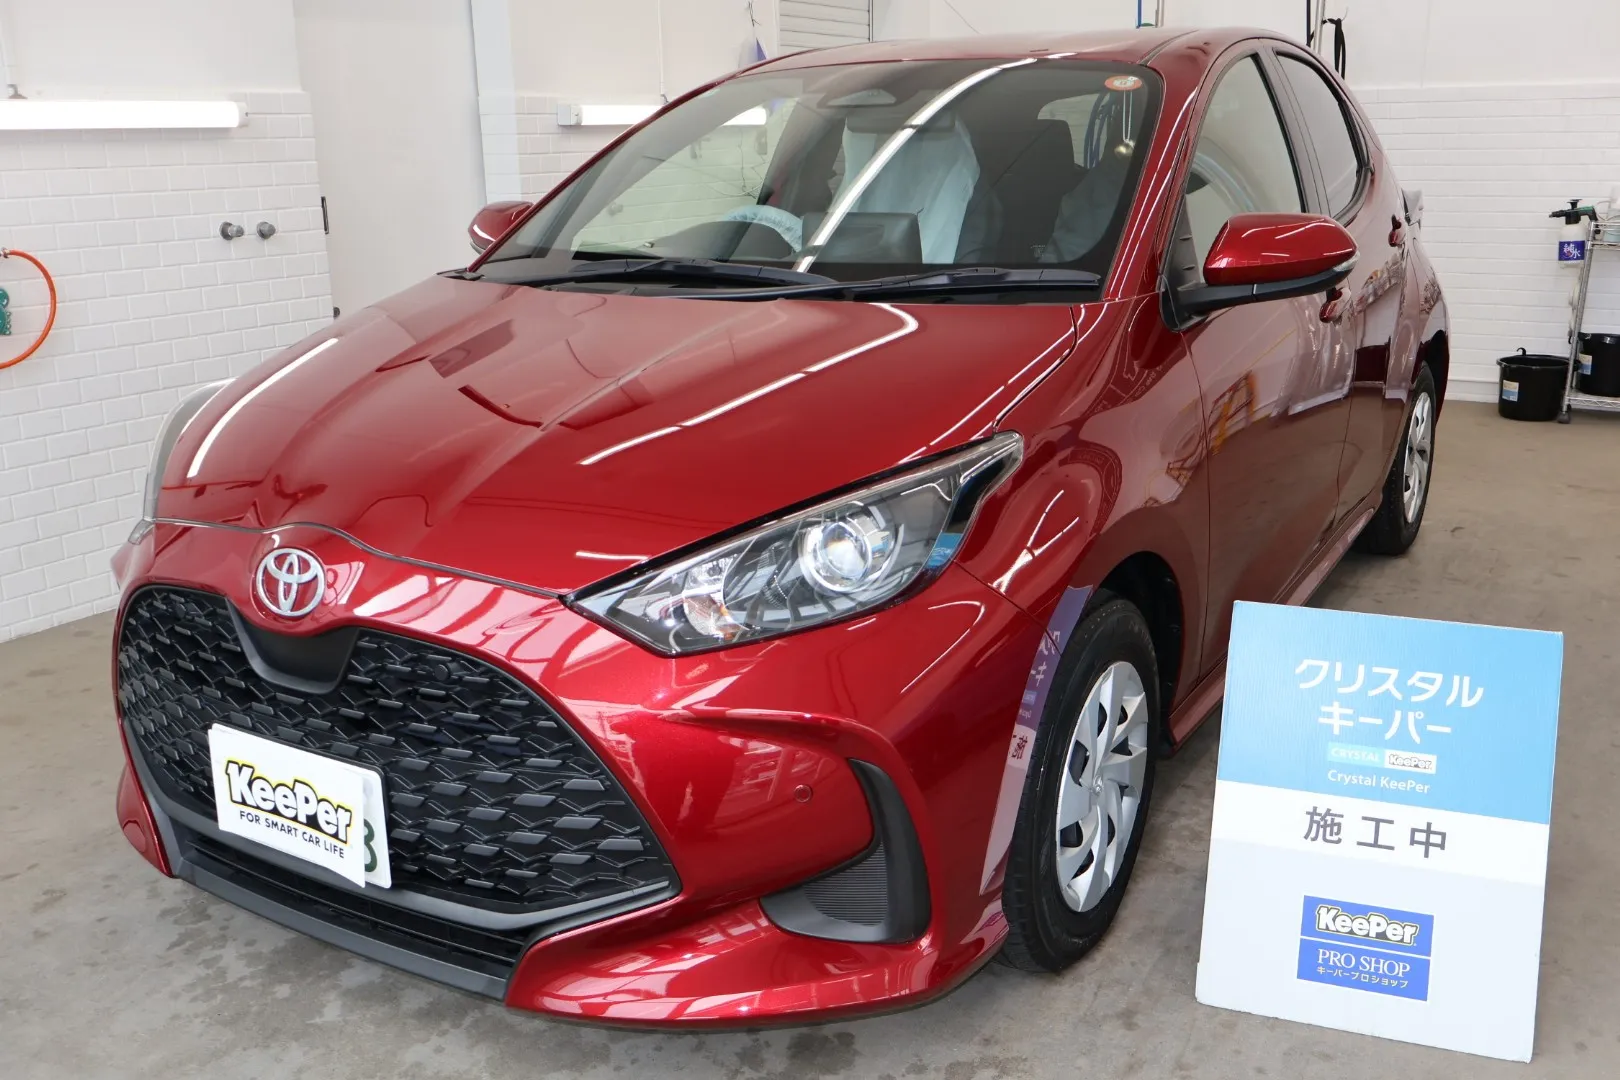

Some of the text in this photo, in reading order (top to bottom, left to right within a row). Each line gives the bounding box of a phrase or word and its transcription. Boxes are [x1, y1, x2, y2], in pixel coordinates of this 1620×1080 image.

[1295, 659, 1484, 707] クリスタル
[1317, 702, 1452, 744] キーパー
[1330, 747, 1433, 770] CRYSTAL KeePer
[225, 760, 353, 844] KeePer
[1327, 769, 1430, 794] Crystal KeePer
[240, 811, 345, 858] FOR SMART CAR LIFE
[1315, 904, 1419, 946] KeePer
[1317, 948, 1410, 978] PRO SHOP
[1317, 966, 1408, 987] キーパープロショップ
